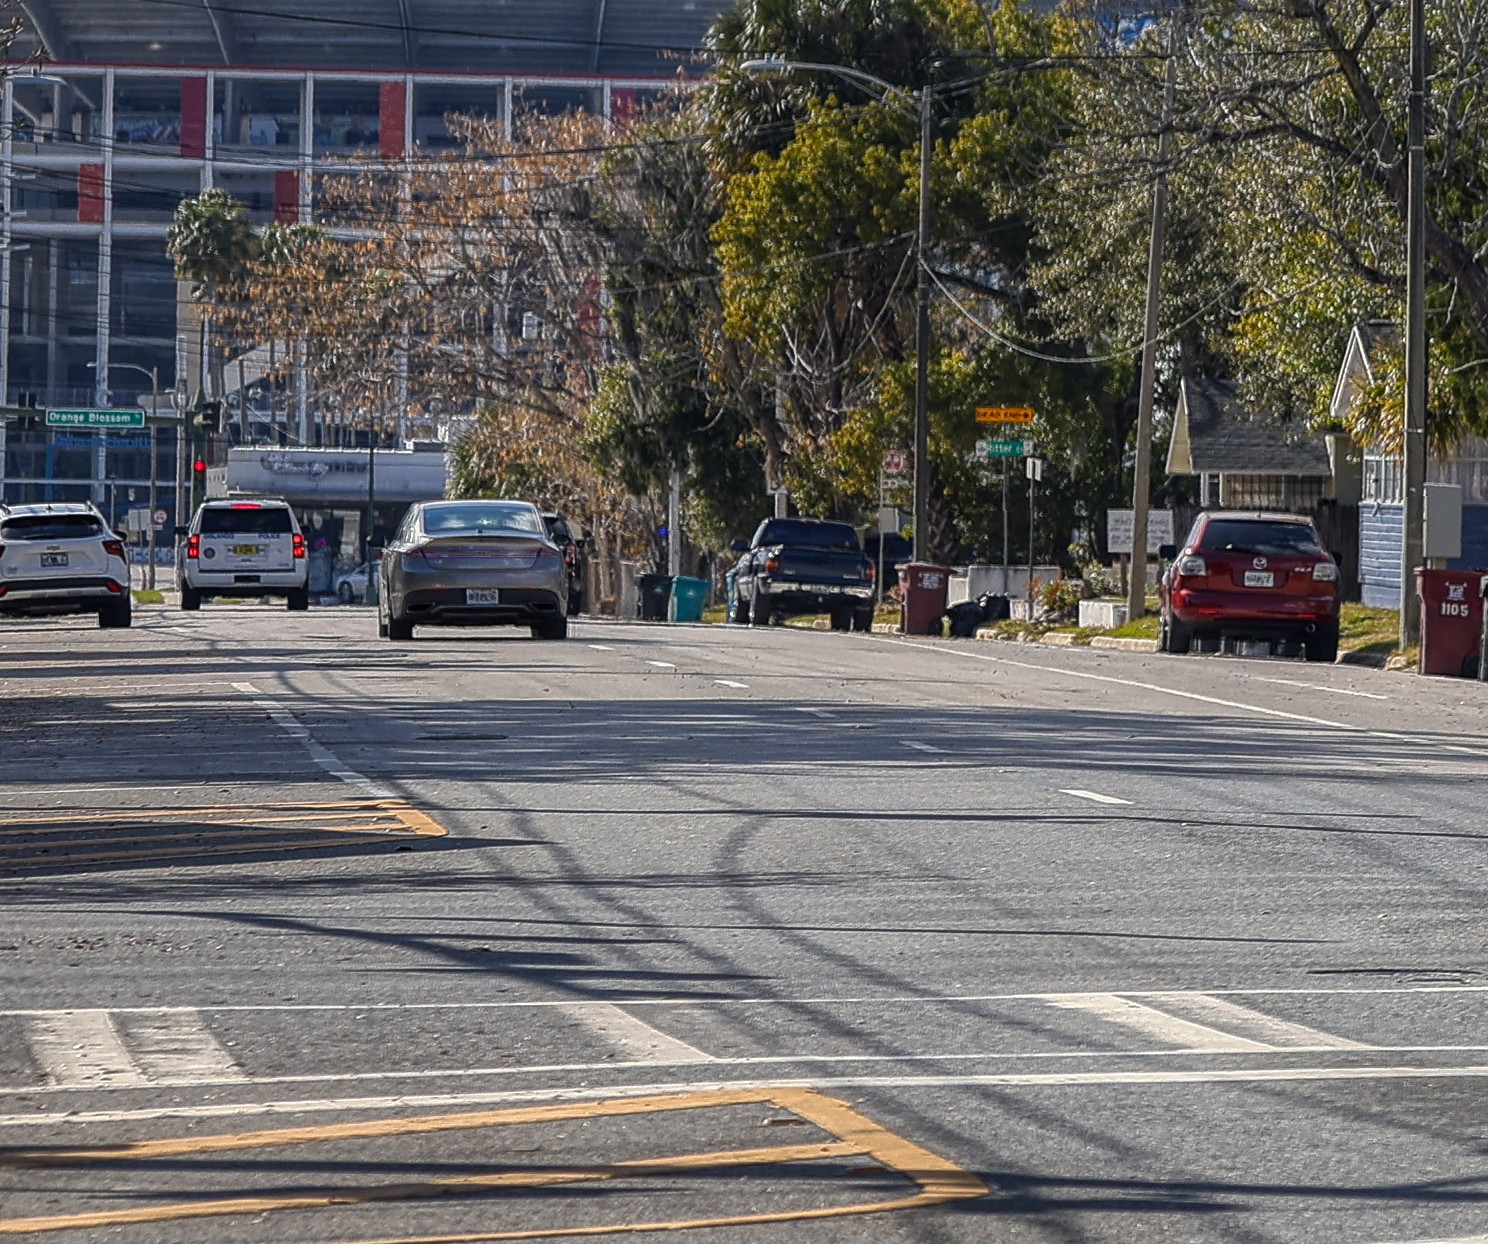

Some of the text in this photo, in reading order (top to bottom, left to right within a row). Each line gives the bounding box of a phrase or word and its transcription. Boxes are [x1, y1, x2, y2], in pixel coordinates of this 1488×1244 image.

[49, 412, 85, 424] Orange
[89, 413, 131, 423] Blossom
[1440, 602, 1469, 617] 1105
